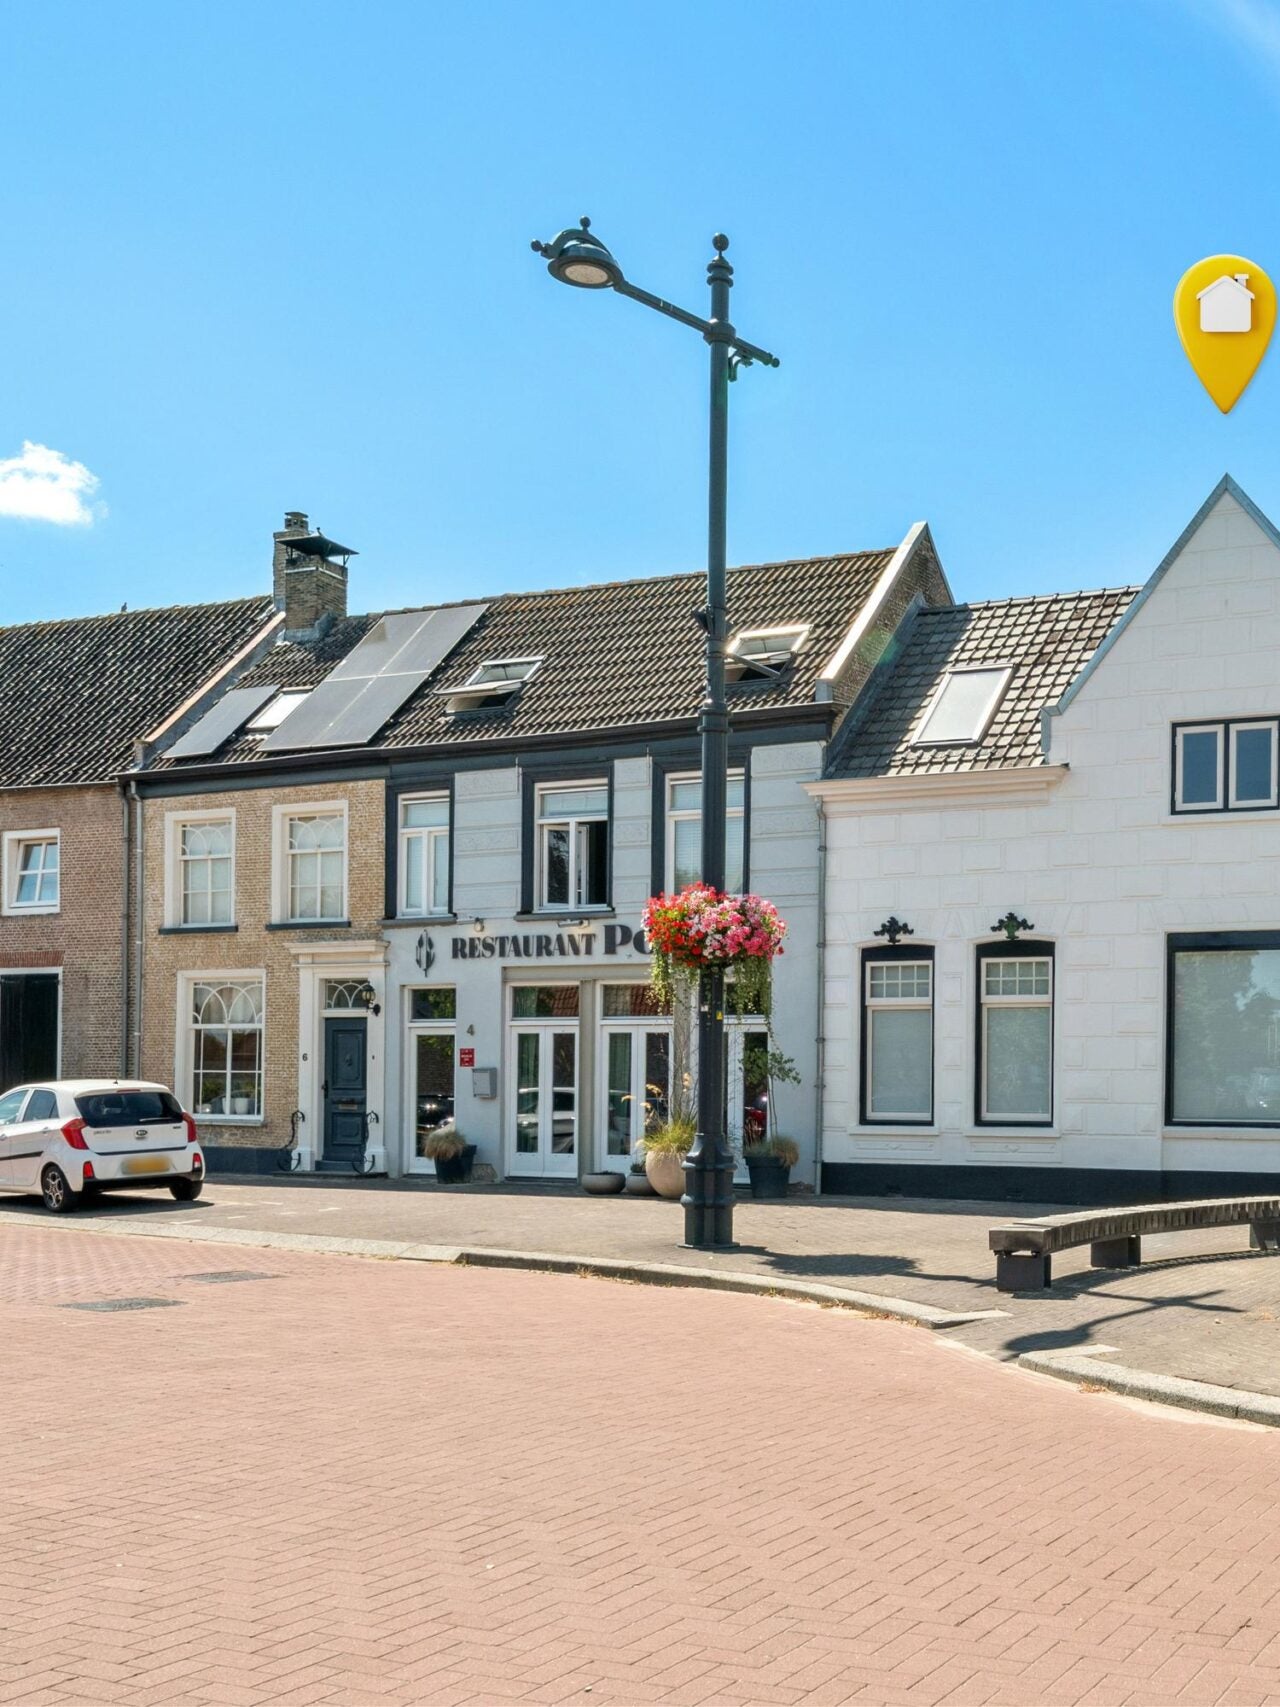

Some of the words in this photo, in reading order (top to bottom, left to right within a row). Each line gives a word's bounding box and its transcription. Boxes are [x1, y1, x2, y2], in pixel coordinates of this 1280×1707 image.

[451, 933, 596, 959] RESTAURANT
[466, 1024, 475, 1036] 4
[302, 1052, 308, 1061] 6
